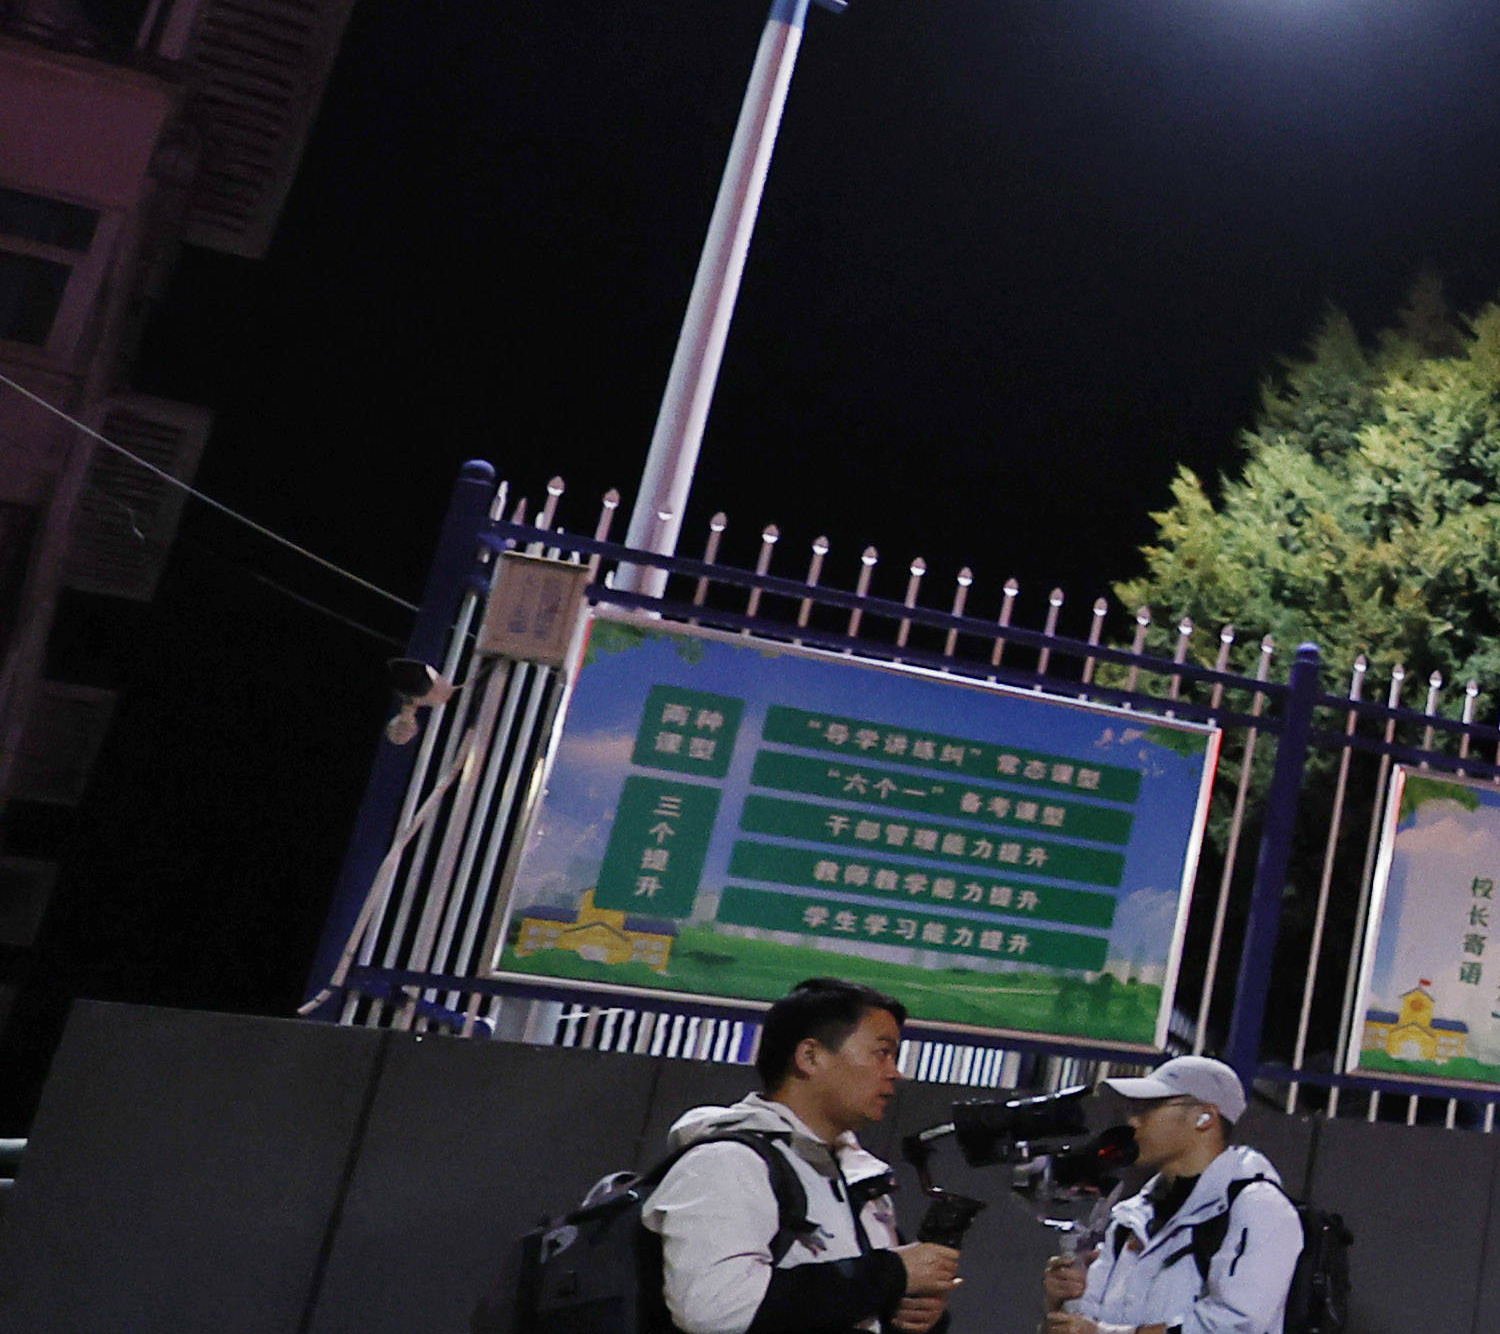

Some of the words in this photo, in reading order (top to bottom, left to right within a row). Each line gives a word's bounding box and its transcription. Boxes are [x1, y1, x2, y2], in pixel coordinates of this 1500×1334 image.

[661, 702, 725, 733] 两种
[633, 794, 683, 898] 三个提升
[825, 813, 1050, 869] 干部管理能力提升
[813, 859, 1040, 912] 教师教学能力提升
[803, 904, 1031, 956] 学生学习能力提升
[1459, 875, 1494, 985] 校长寄语
